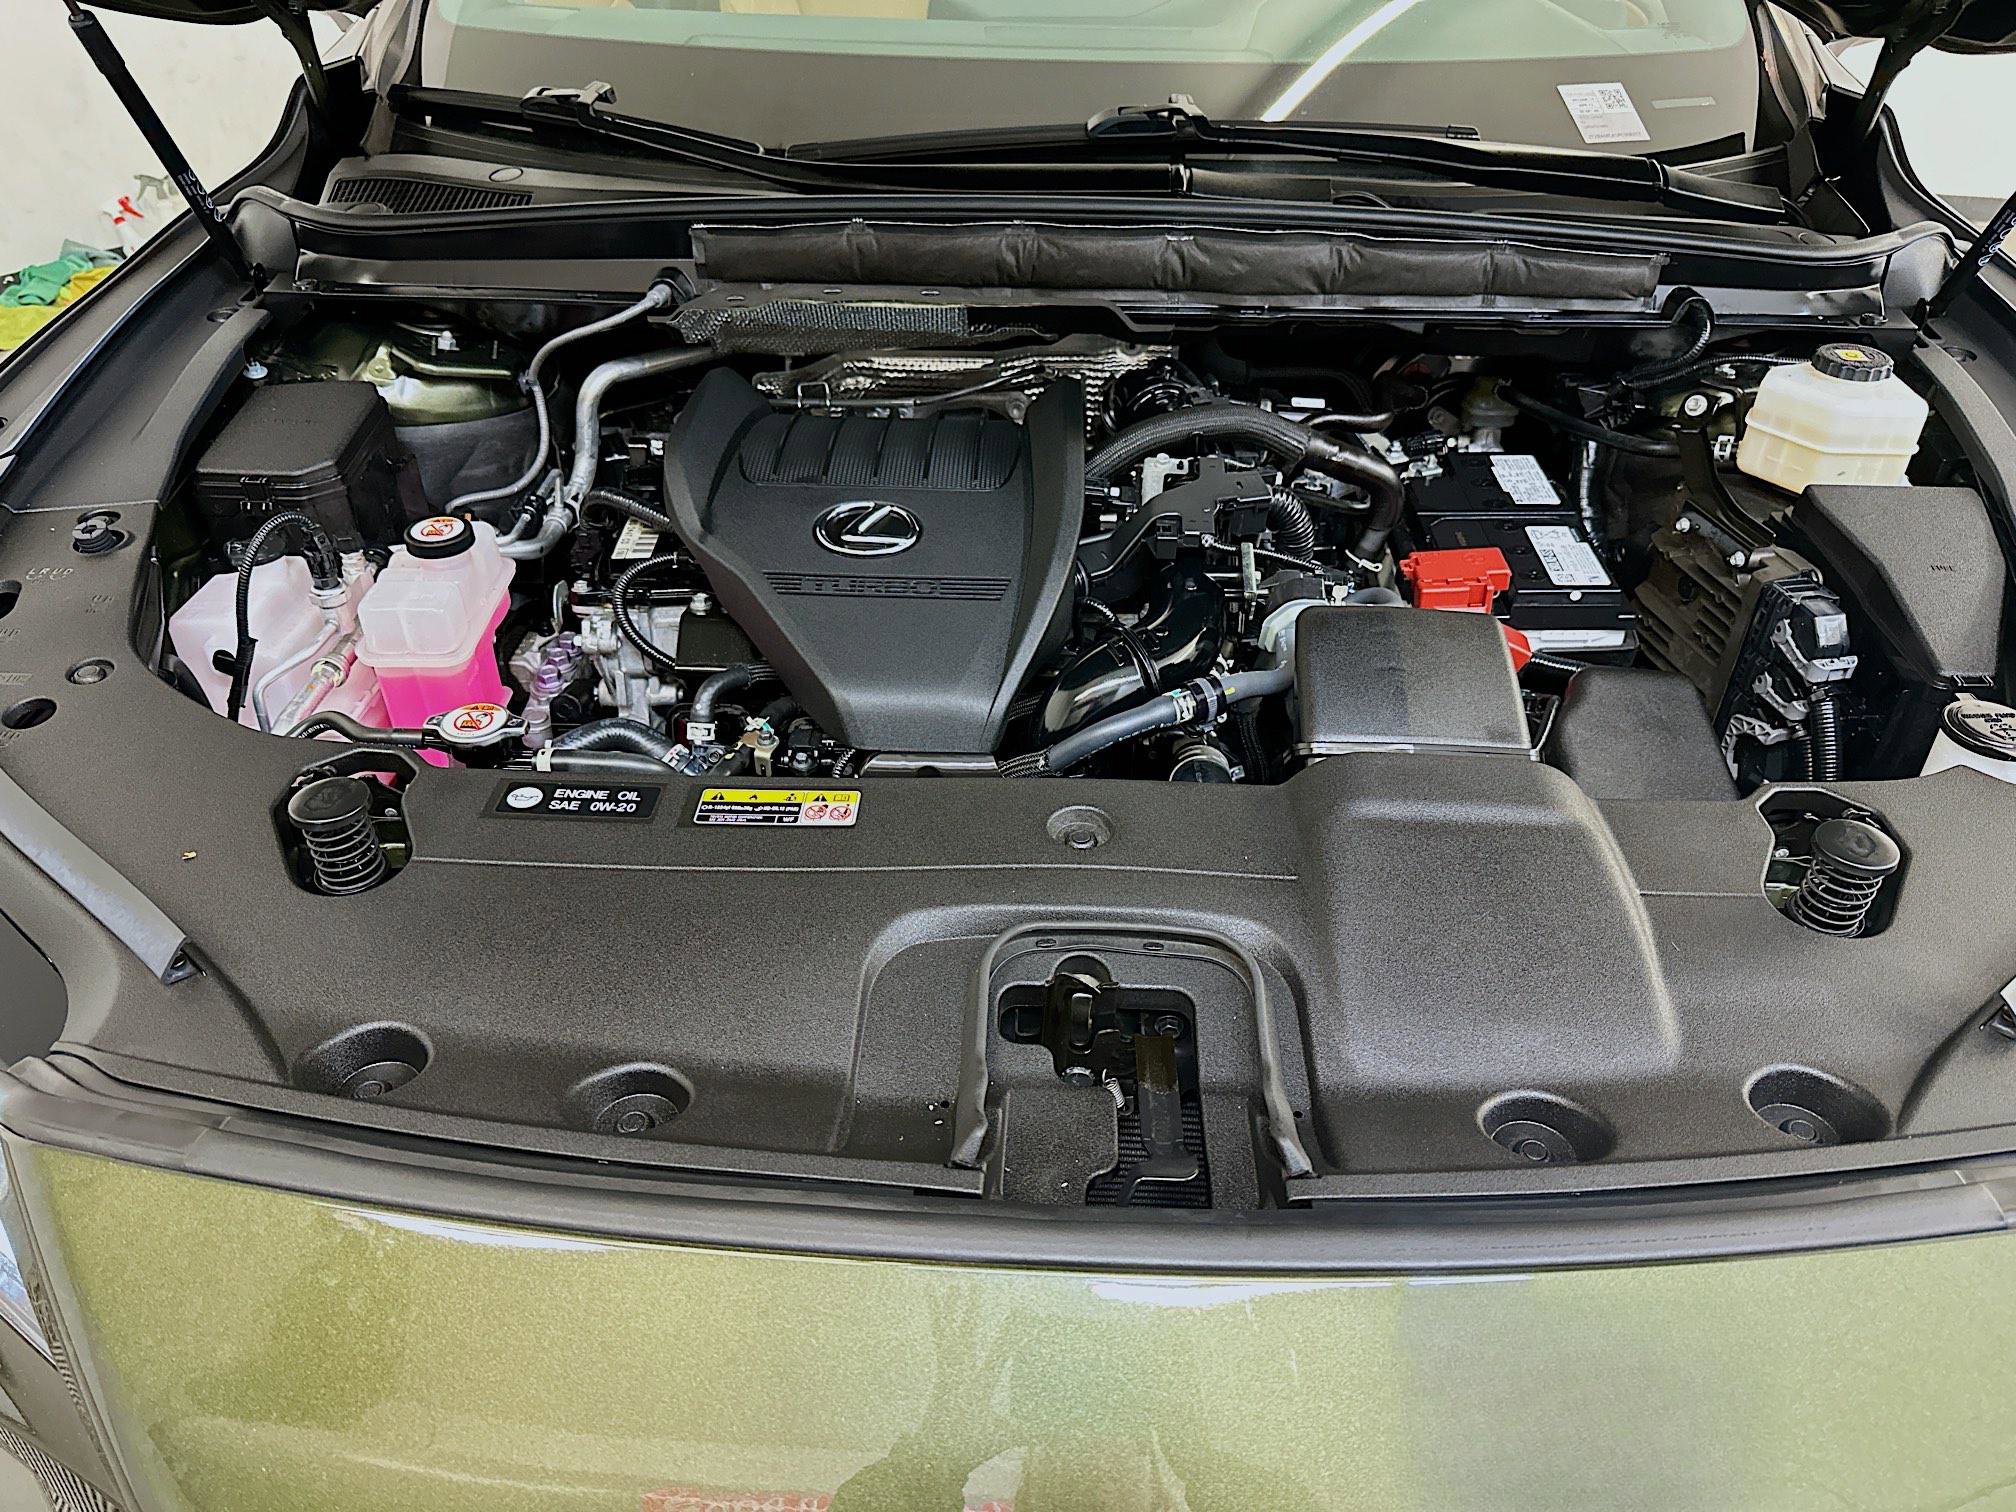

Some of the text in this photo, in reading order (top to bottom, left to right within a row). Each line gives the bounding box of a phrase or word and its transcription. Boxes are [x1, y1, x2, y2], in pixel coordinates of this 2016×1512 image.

[554, 788, 641, 801] ENGINE OIL
[548, 800, 637, 813] SAE 0W-20
